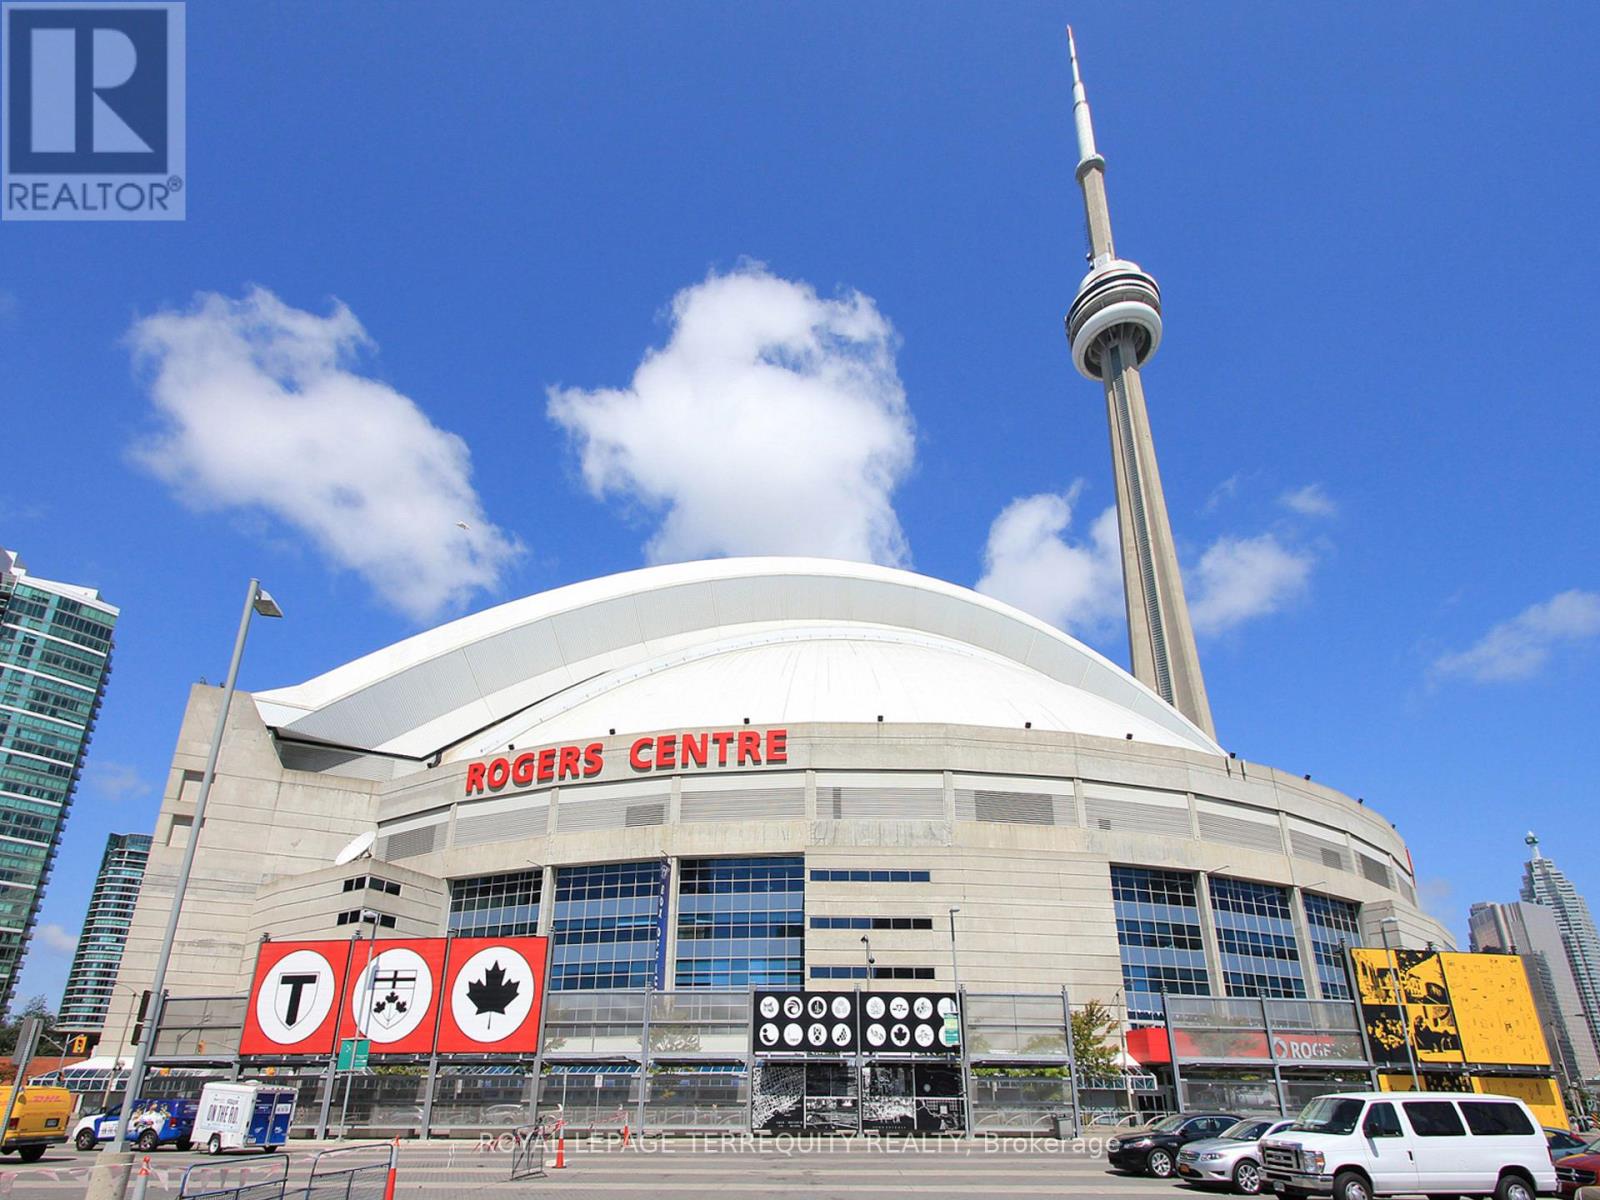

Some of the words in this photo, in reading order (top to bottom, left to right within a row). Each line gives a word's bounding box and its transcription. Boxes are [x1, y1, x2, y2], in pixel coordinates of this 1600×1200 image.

[466, 743, 603, 796] ROGERS
[630, 728, 788, 772] CENTRE
[280, 973, 318, 1027] T
